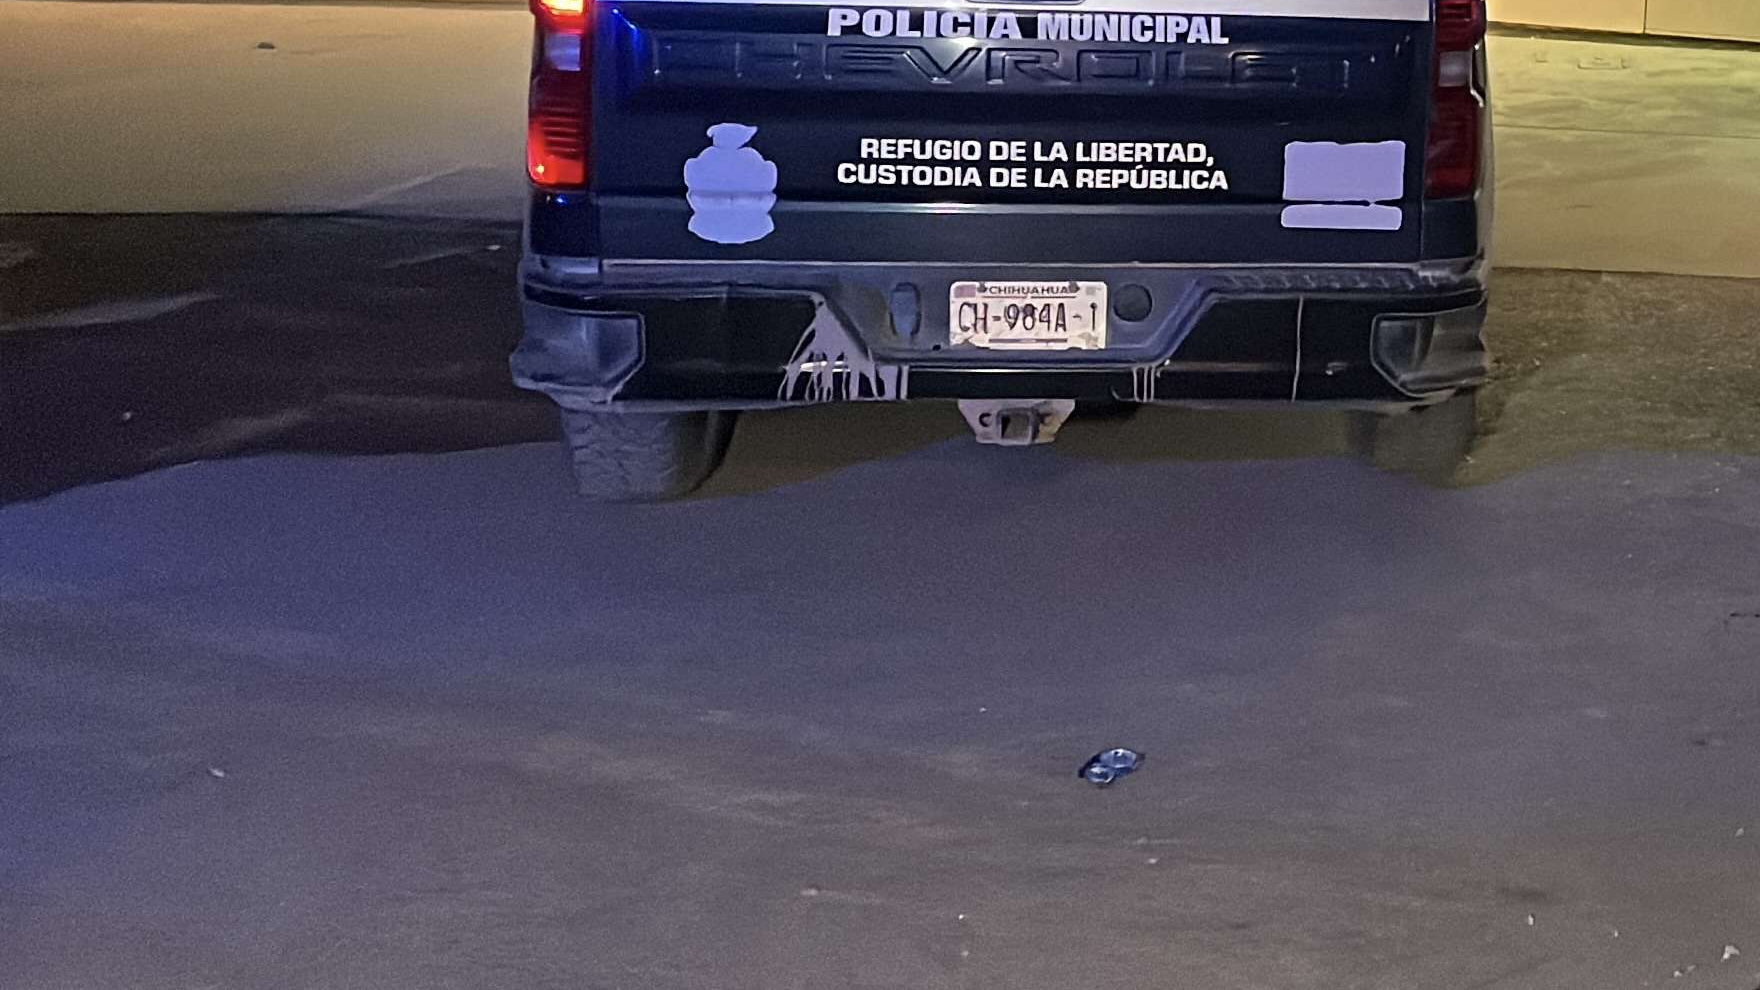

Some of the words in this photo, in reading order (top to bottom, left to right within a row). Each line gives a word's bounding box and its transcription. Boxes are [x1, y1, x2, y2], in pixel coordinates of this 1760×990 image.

[1037, 11, 1230, 45] MUNICIPAL
[860, 138, 981, 161] REFUGIO
[988, 140, 1027, 162] DE
[1033, 141, 1069, 163] LA
[1075, 142, 1215, 167] LIBERTAD,
[837, 162, 982, 187] CUSTODIA
[989, 167, 1027, 188] DE
[1033, 167, 1069, 188] LA
[1075, 164, 1229, 190] REPÚBLICA
[988, 285, 1070, 295] CHIHUAHUA
